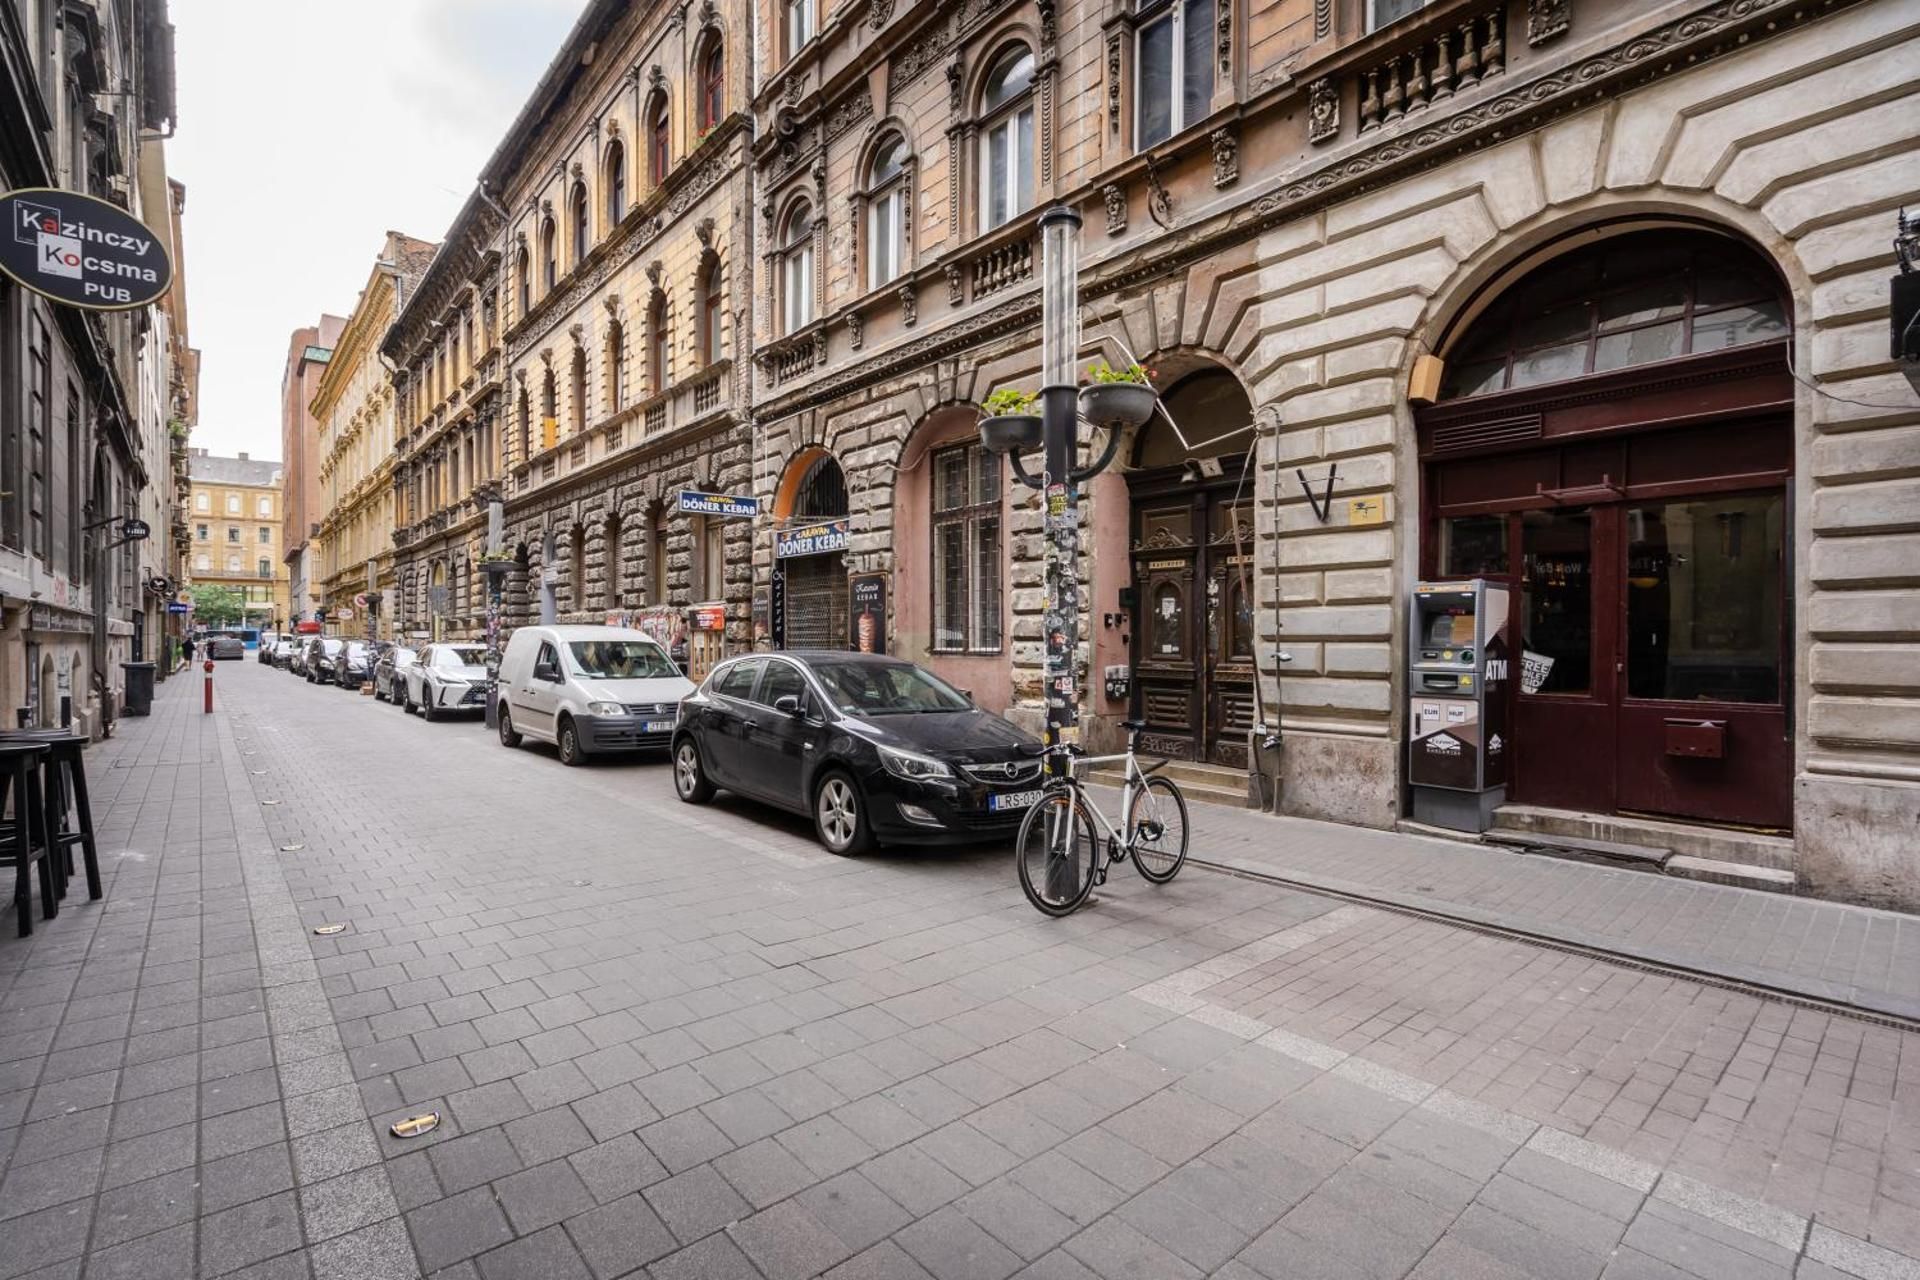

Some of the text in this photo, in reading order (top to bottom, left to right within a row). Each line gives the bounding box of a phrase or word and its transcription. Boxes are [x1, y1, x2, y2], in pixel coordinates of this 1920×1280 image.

[22, 209, 150, 256] Kazinczy
[45, 244, 157, 283] Kocsma
[84, 282, 132, 302] PUB
[683, 497, 756, 514] DÖNER KEBAB
[1485, 660, 1507, 680] ATM
